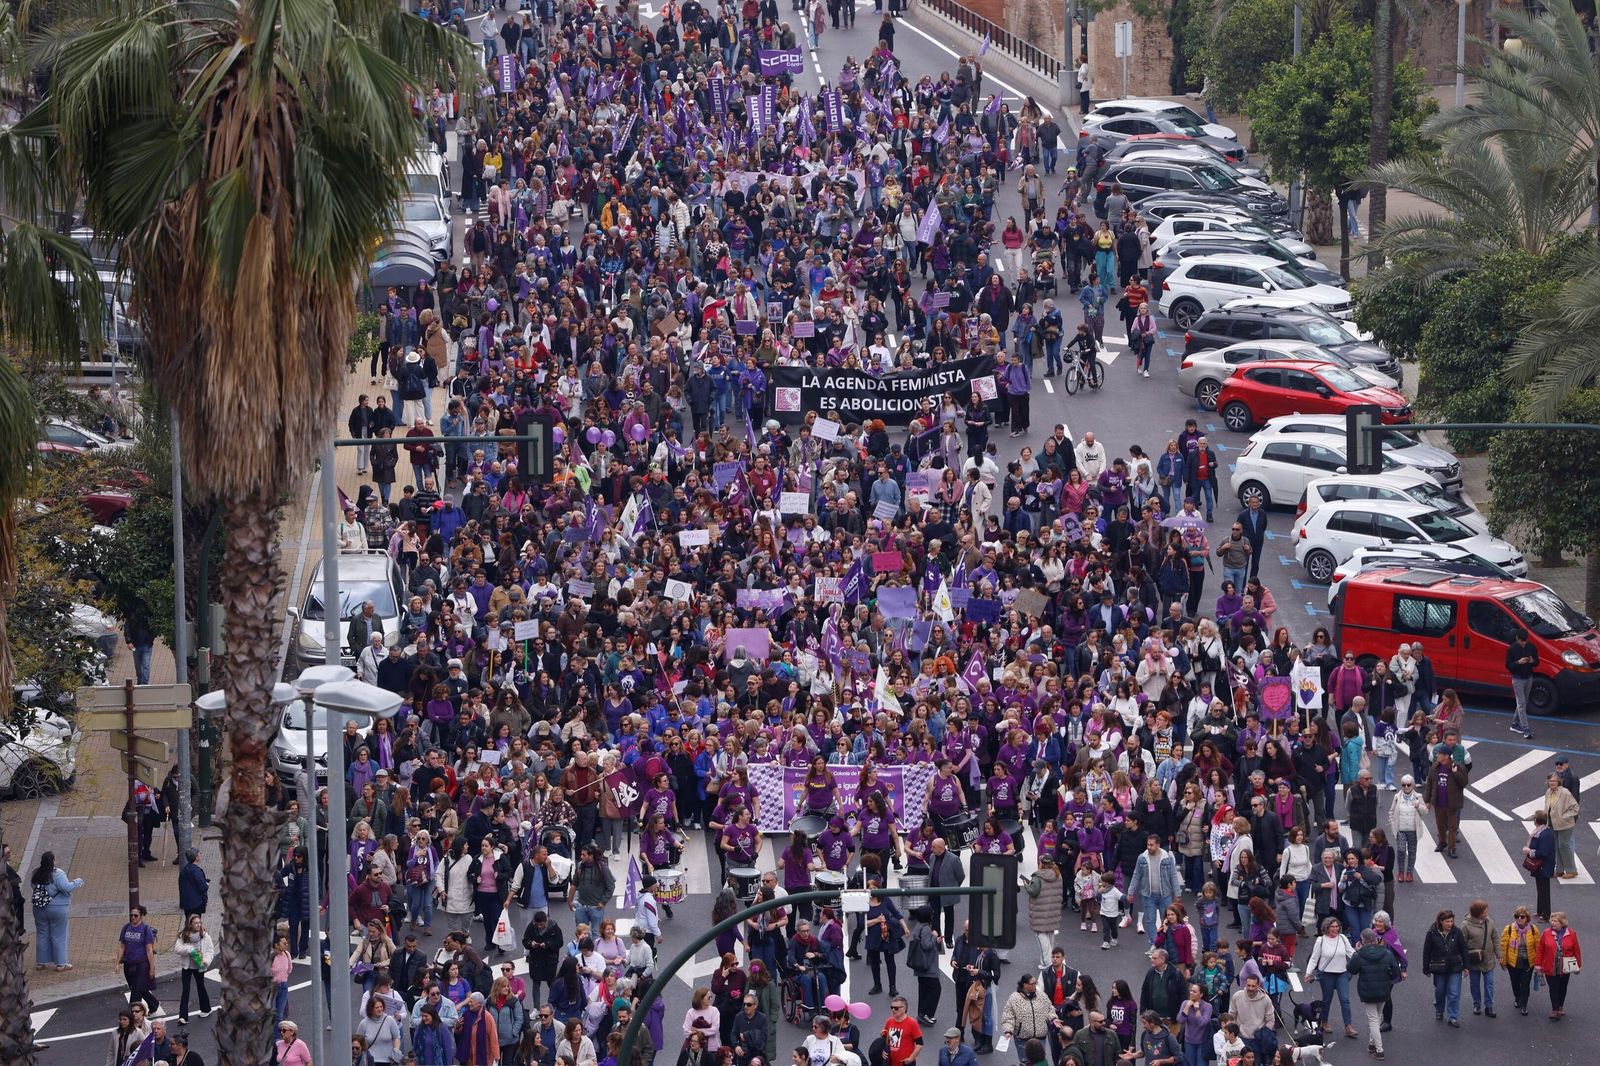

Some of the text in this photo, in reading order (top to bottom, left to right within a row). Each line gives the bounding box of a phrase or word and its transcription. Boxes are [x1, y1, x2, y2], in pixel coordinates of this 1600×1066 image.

[802, 369, 966, 392] LA AGENDA FEMINISTA
[820, 397, 836, 409] ES
